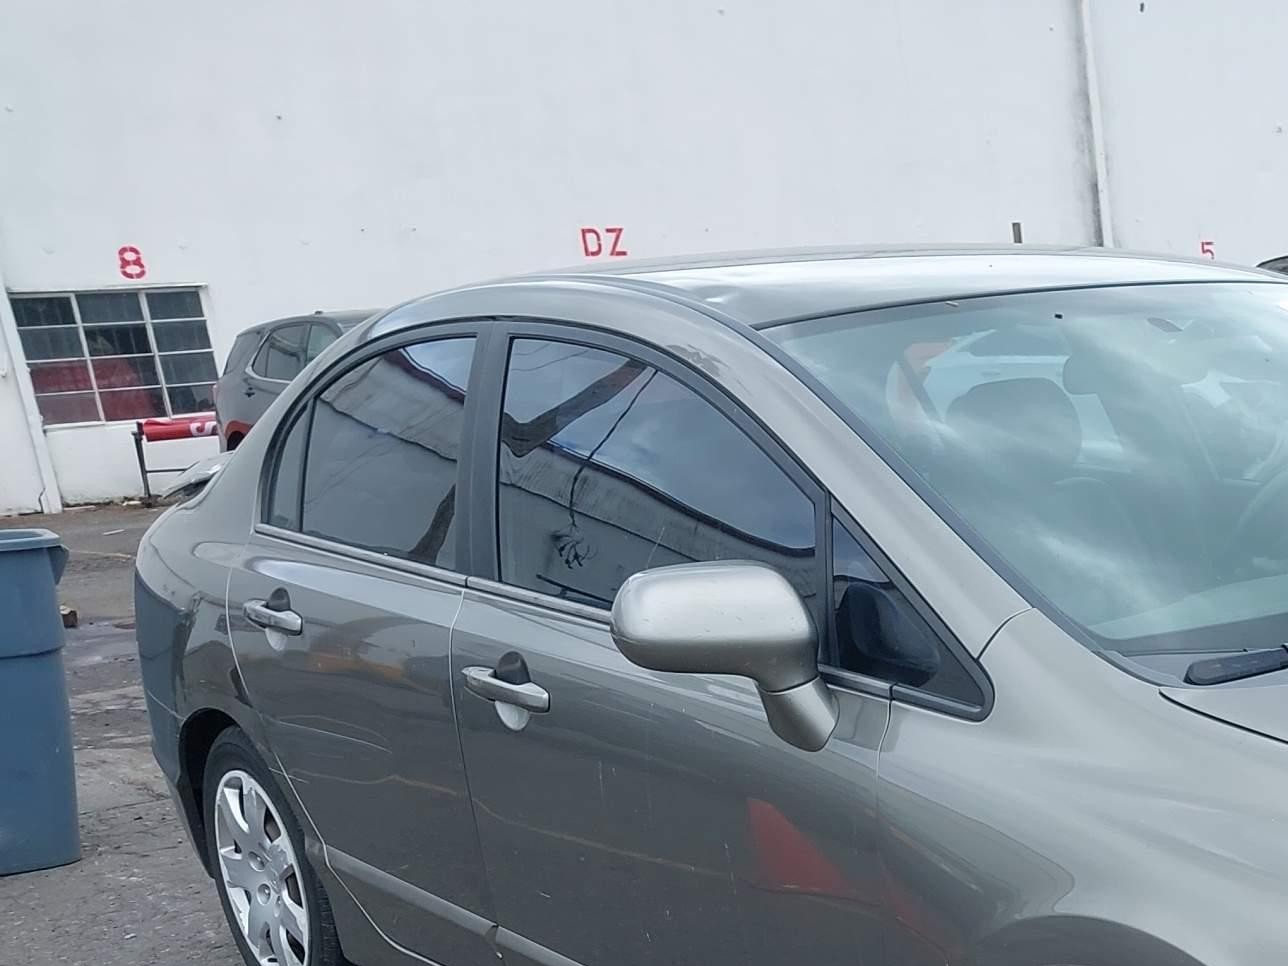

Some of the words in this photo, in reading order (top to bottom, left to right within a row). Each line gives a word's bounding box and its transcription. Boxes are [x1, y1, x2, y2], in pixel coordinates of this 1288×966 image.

[580, 227, 628, 256] DZ
[1201, 241, 1214, 260] 5
[118, 246, 146, 279] 8
